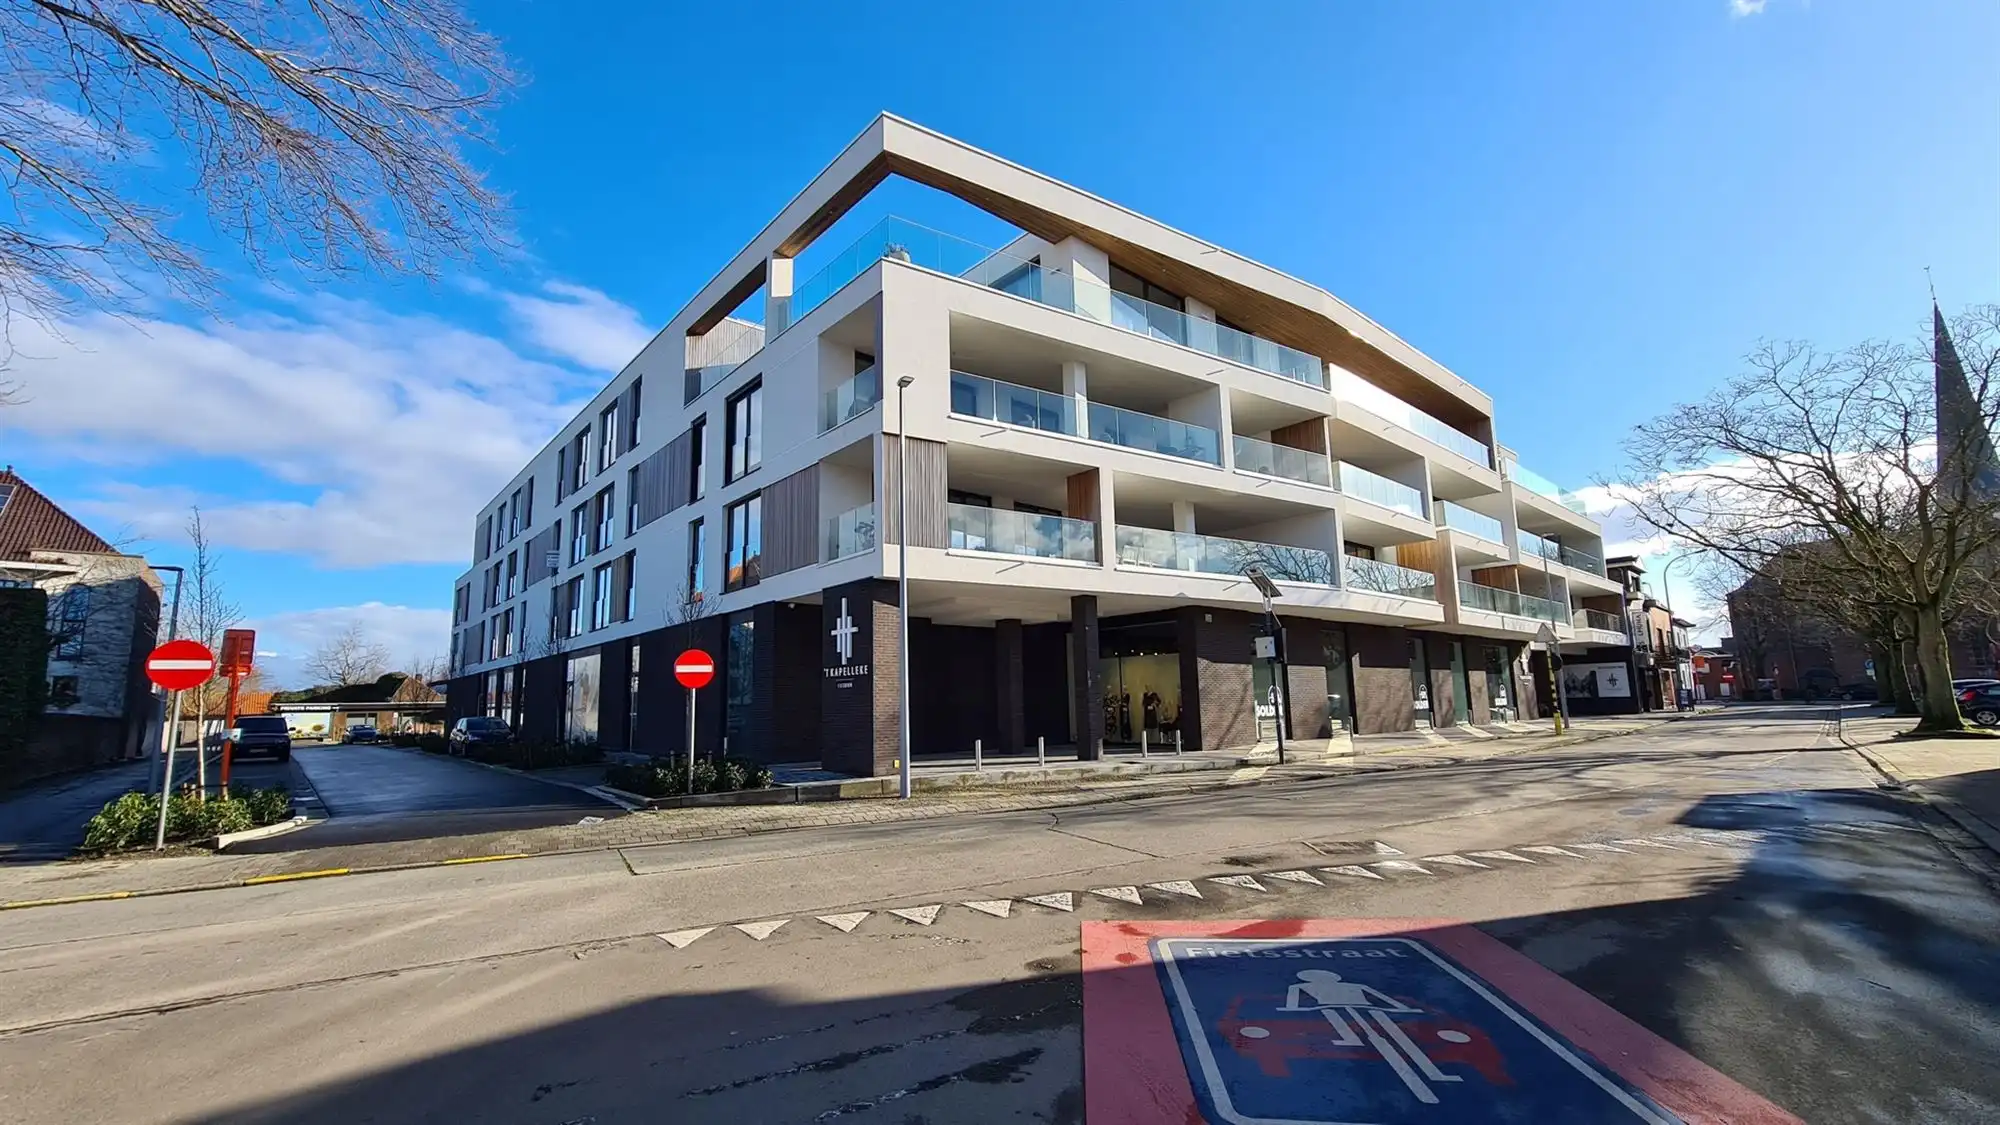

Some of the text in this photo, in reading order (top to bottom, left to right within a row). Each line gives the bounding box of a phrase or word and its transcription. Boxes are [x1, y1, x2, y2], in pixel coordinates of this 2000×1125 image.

[830, 665, 868, 677] KAPELLEKE
[1255, 704, 1284, 717] SOLD
[1184, 946, 1408, 959] Fietsstraat
